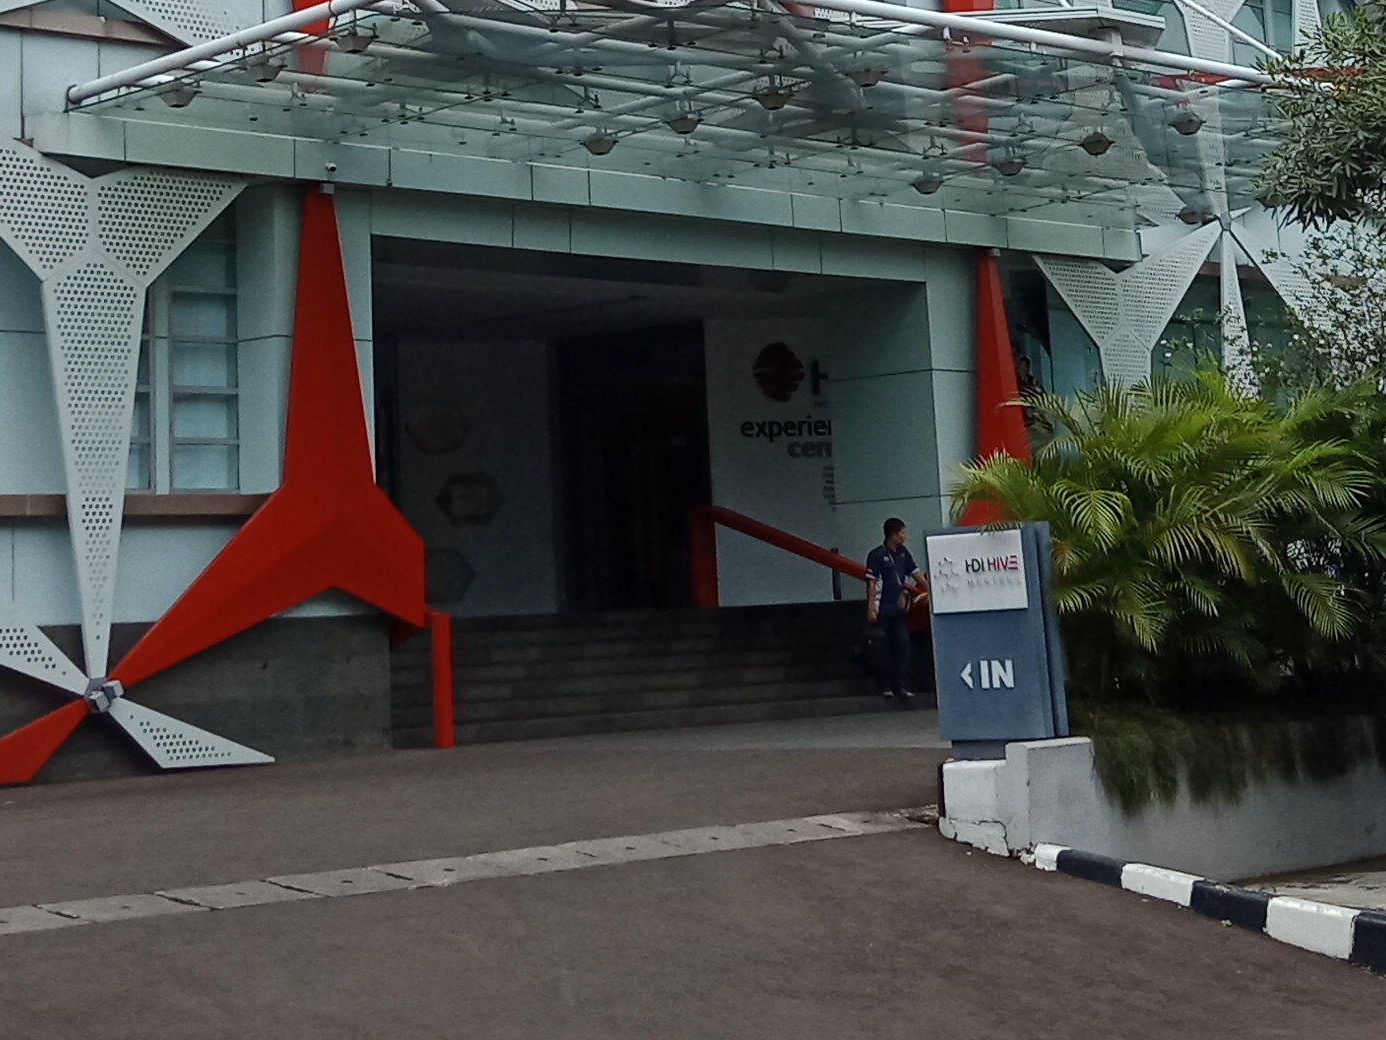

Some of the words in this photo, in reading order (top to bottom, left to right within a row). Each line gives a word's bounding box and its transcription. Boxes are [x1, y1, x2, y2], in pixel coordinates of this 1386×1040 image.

[965, 558, 984, 573] HDI
[987, 555, 1019, 572] HIVE
[979, 659, 1015, 689] IN
